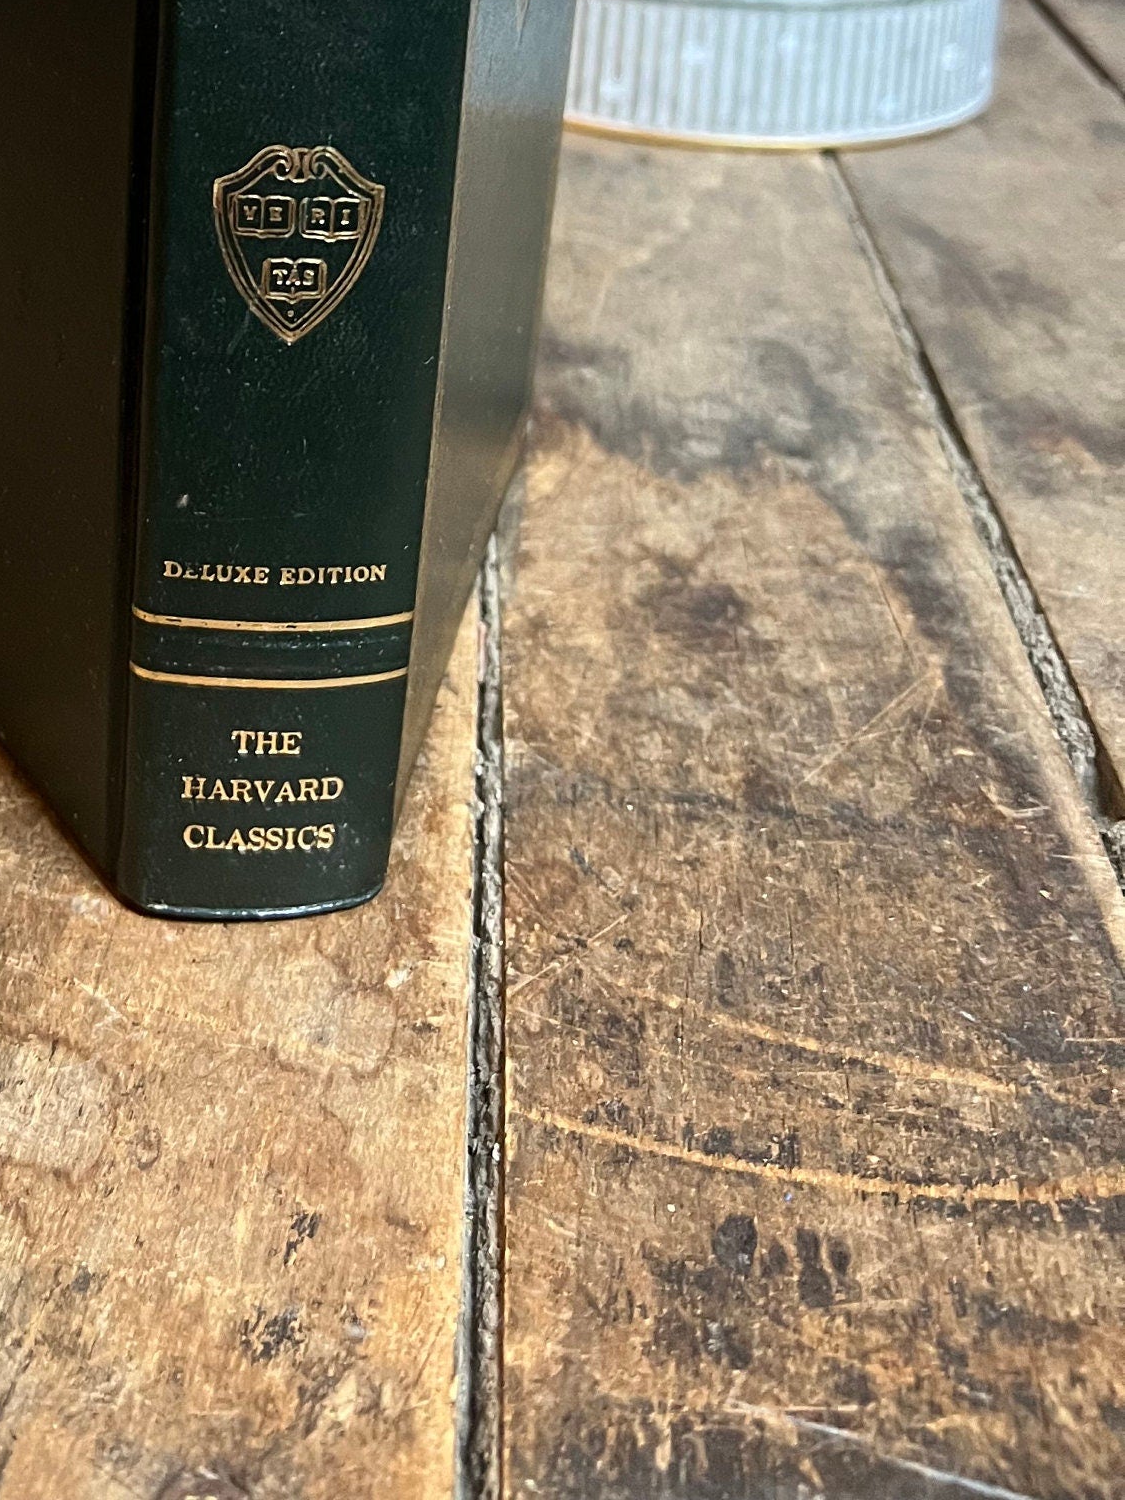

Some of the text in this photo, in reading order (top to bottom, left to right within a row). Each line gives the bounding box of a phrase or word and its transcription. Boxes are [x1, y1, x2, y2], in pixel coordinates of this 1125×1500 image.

[279, 563, 388, 586] EDITION
[231, 730, 303, 756] THE
[180, 775, 344, 803] HARVARD
[182, 822, 336, 852] CLASSICS
